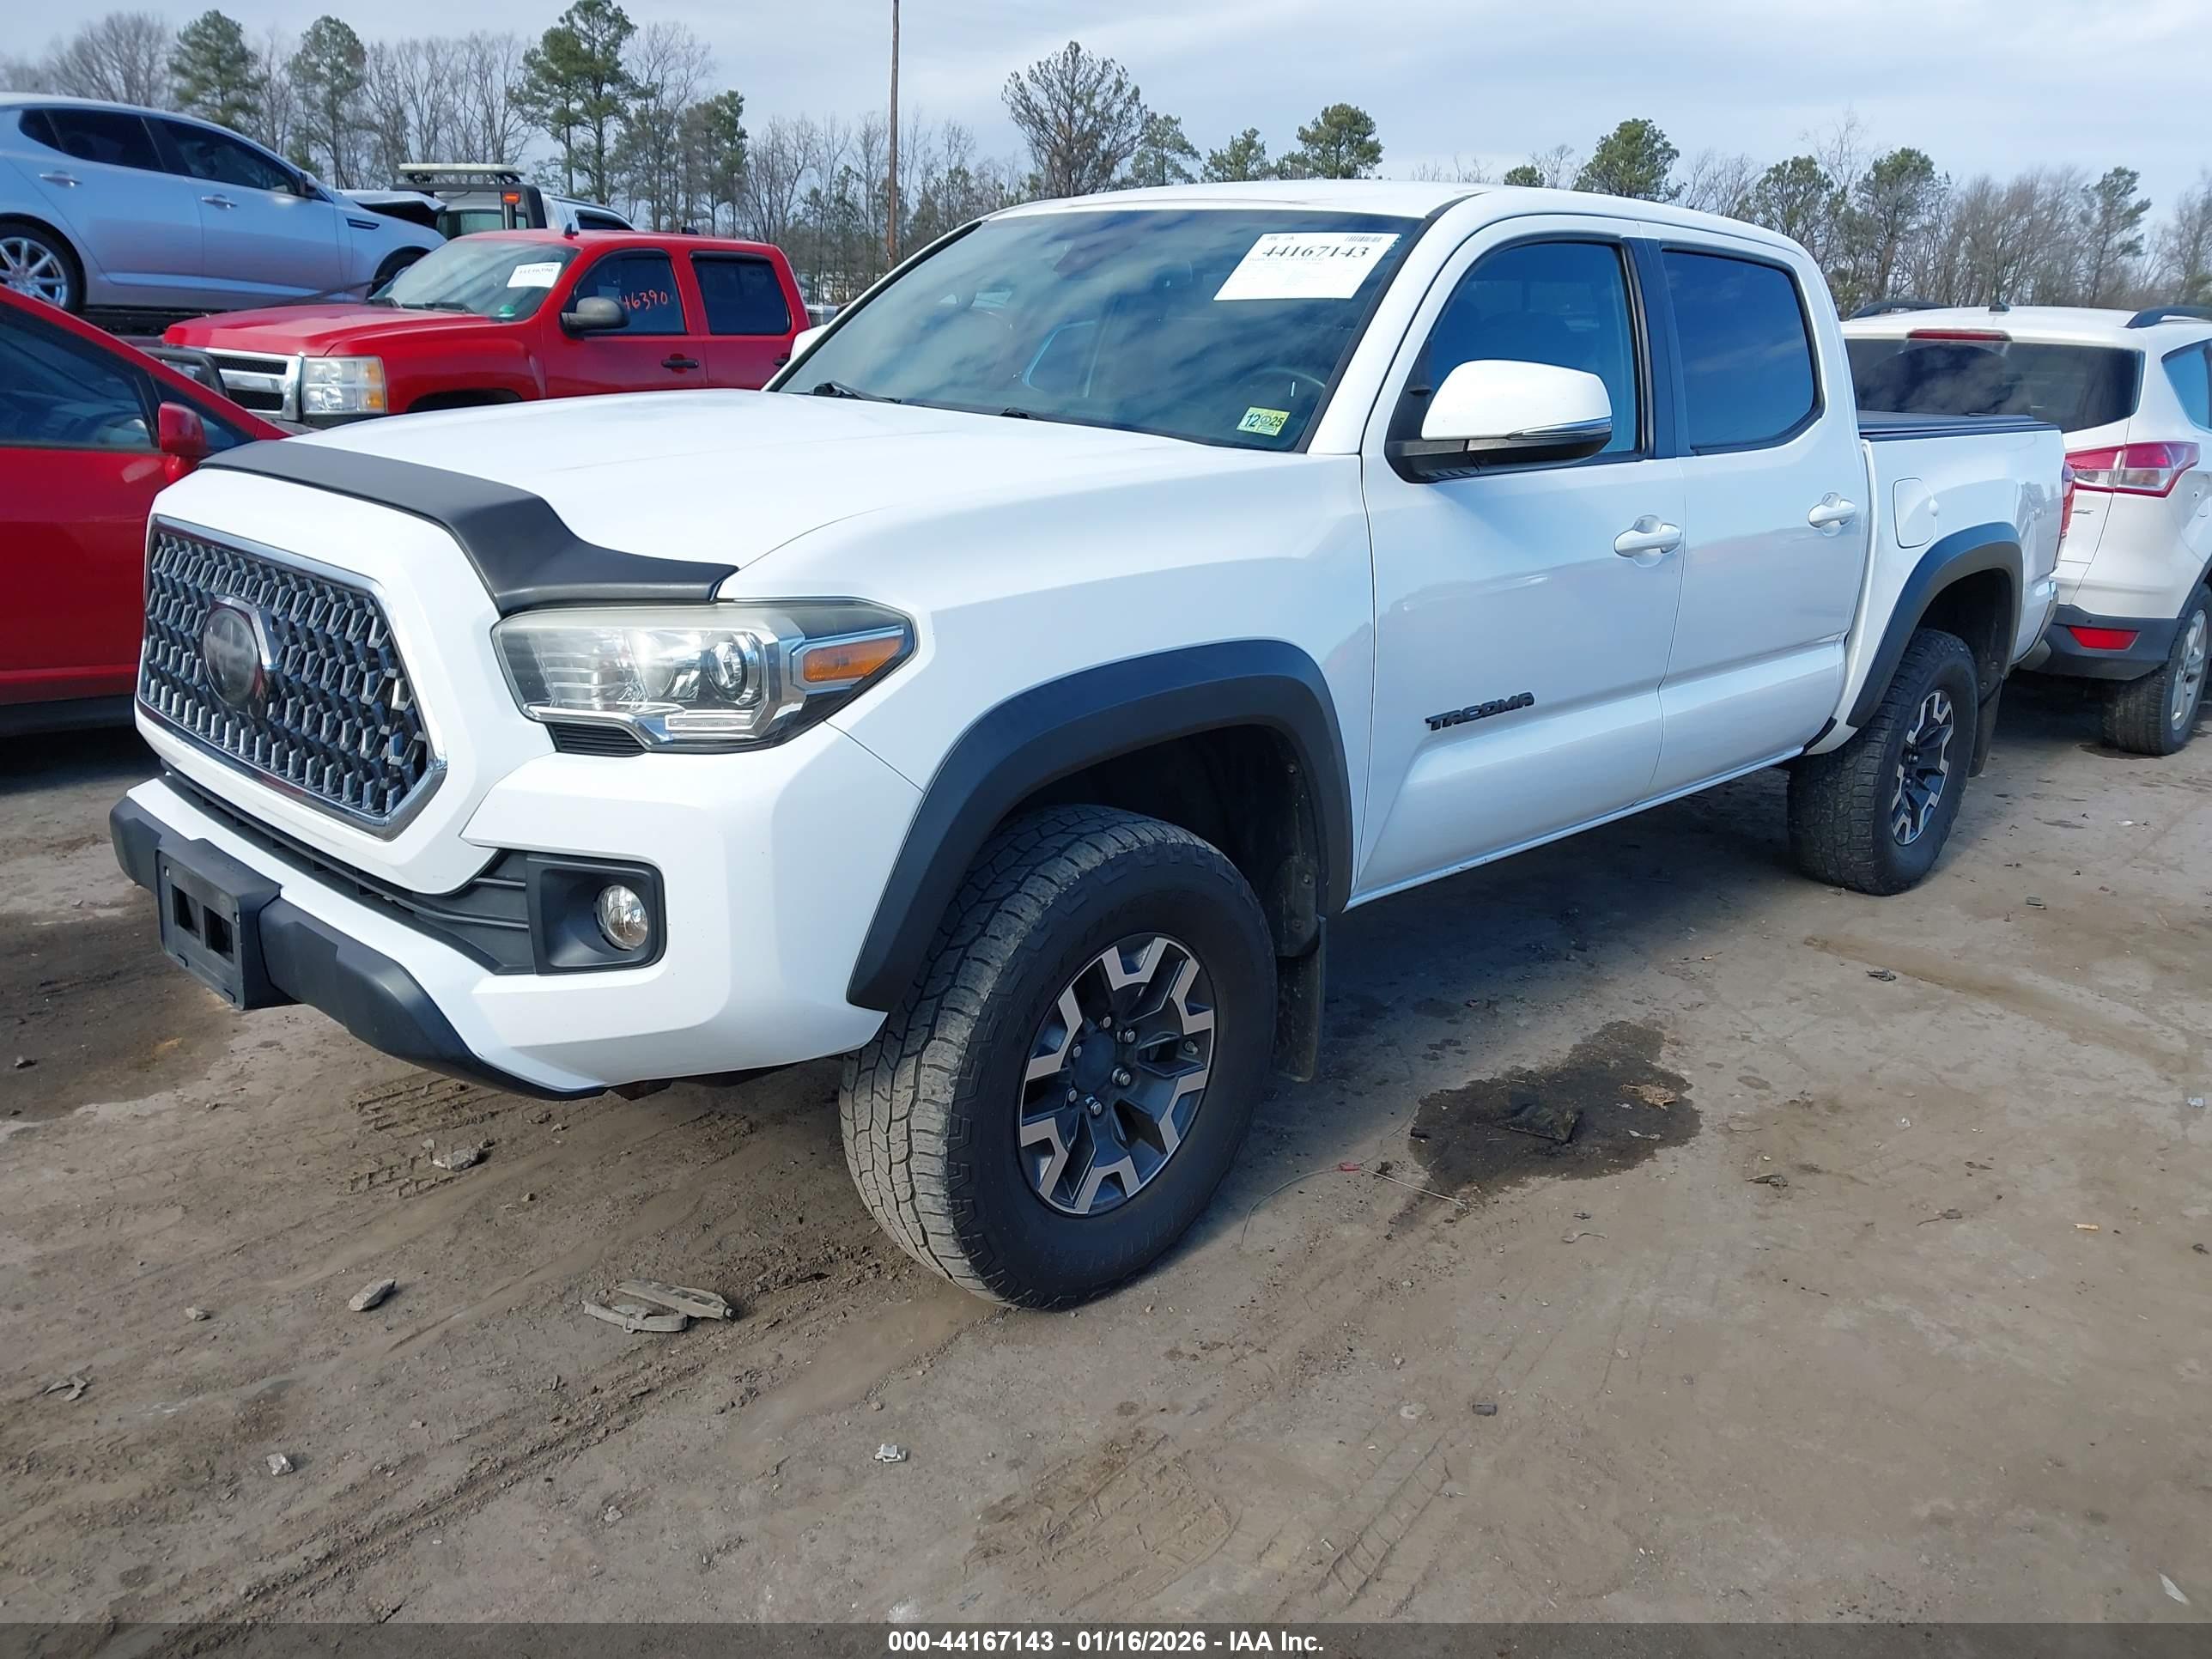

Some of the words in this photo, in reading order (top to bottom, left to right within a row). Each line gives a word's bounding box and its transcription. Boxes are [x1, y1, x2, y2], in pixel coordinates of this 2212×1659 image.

[1262, 246, 1370, 258] 44167143
[1244, 413, 1261, 428] 12
[1269, 416, 1285, 428] 25
[1425, 691, 1535, 732] TACOMA
